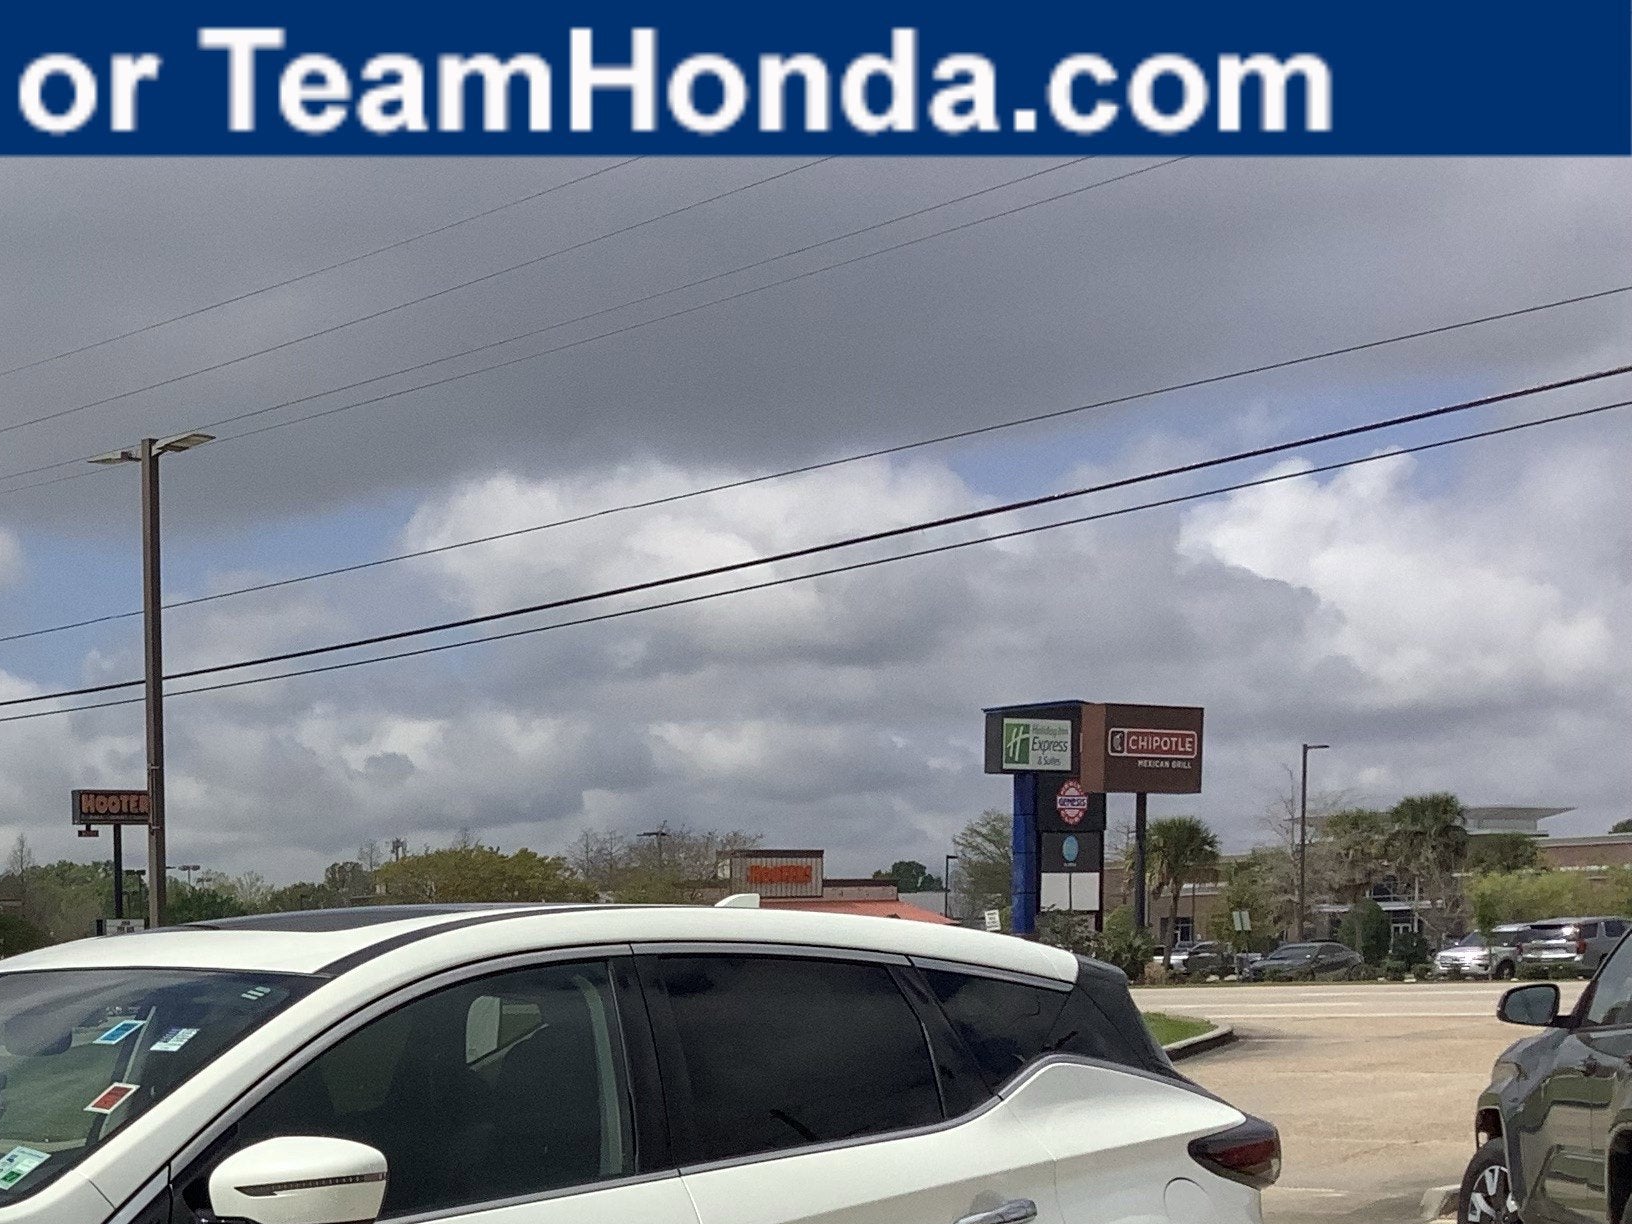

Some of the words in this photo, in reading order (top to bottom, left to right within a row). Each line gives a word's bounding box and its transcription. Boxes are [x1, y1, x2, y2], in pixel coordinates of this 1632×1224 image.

[1031, 736, 1069, 755] Express
[1128, 735, 1194, 752] CHIPOTLE
[1043, 756, 1061, 767] Suites
[1137, 759, 1170, 769] MEXICAN
[1171, 760, 1192, 770] GRILL
[81, 794, 149, 814] HOOTER
